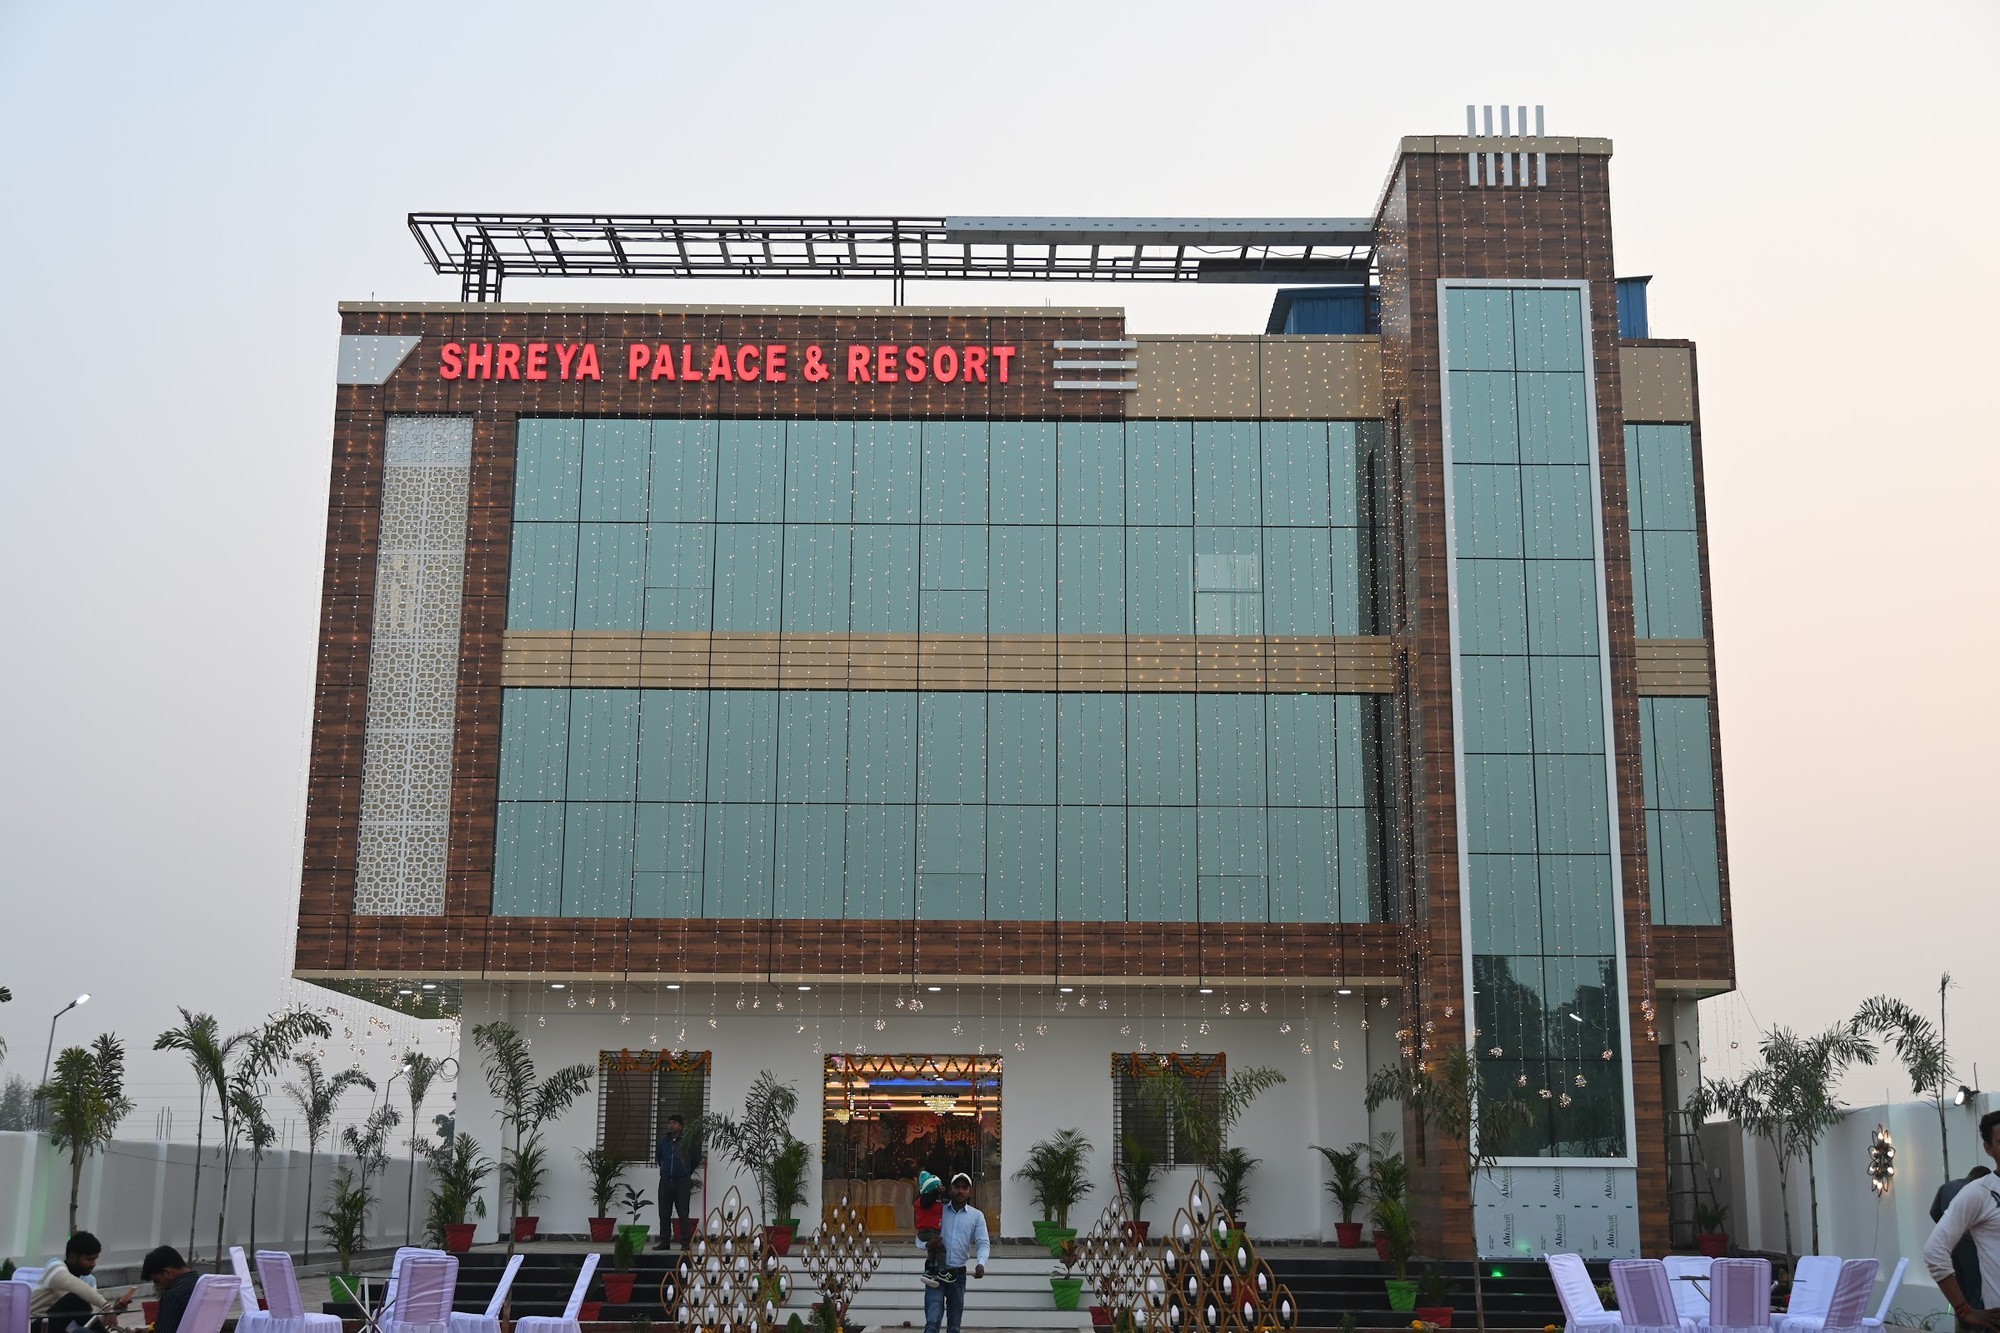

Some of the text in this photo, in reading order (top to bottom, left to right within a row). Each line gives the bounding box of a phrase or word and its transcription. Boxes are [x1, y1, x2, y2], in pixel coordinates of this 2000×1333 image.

[439, 342, 1017, 384] SHREYA PALACE & RESORT
